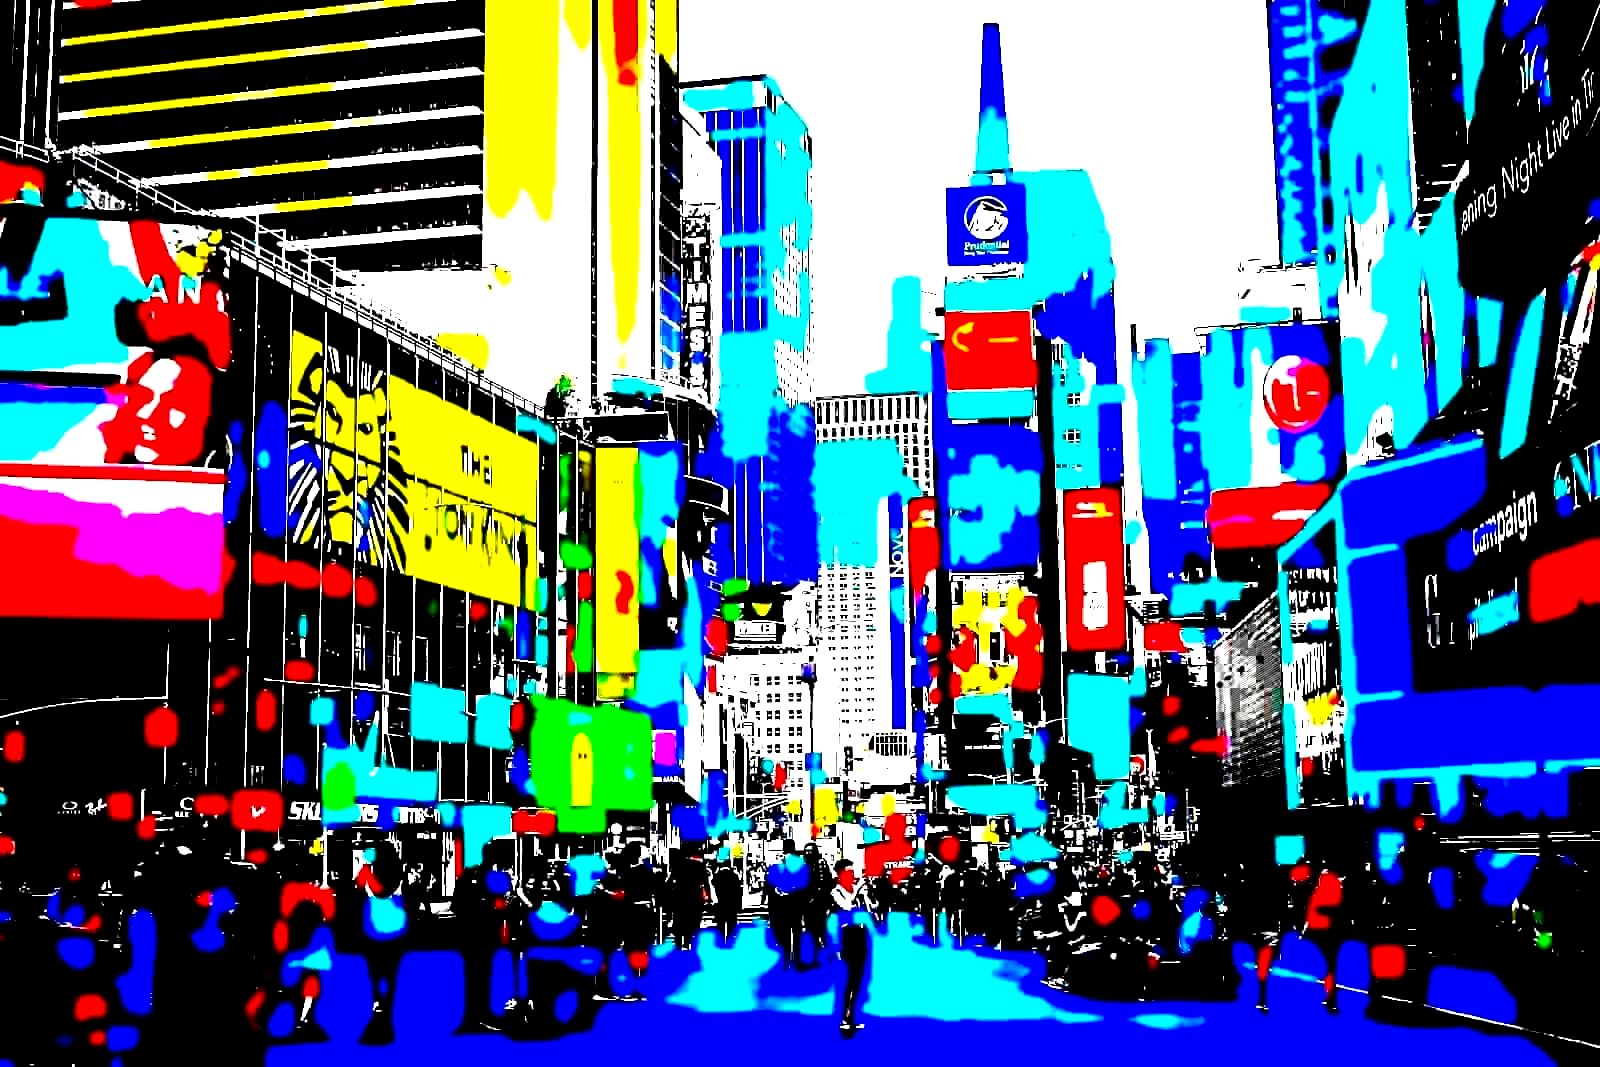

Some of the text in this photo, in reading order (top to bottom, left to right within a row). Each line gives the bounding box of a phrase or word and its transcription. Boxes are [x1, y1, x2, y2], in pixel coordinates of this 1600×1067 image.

[1501, 139, 1544, 199] Night
[1545, 115, 1570, 160] Live
[1570, 95, 1582, 129] in
[682, 236, 708, 352] TIMES
[964, 240, 1010, 251] Prudential
